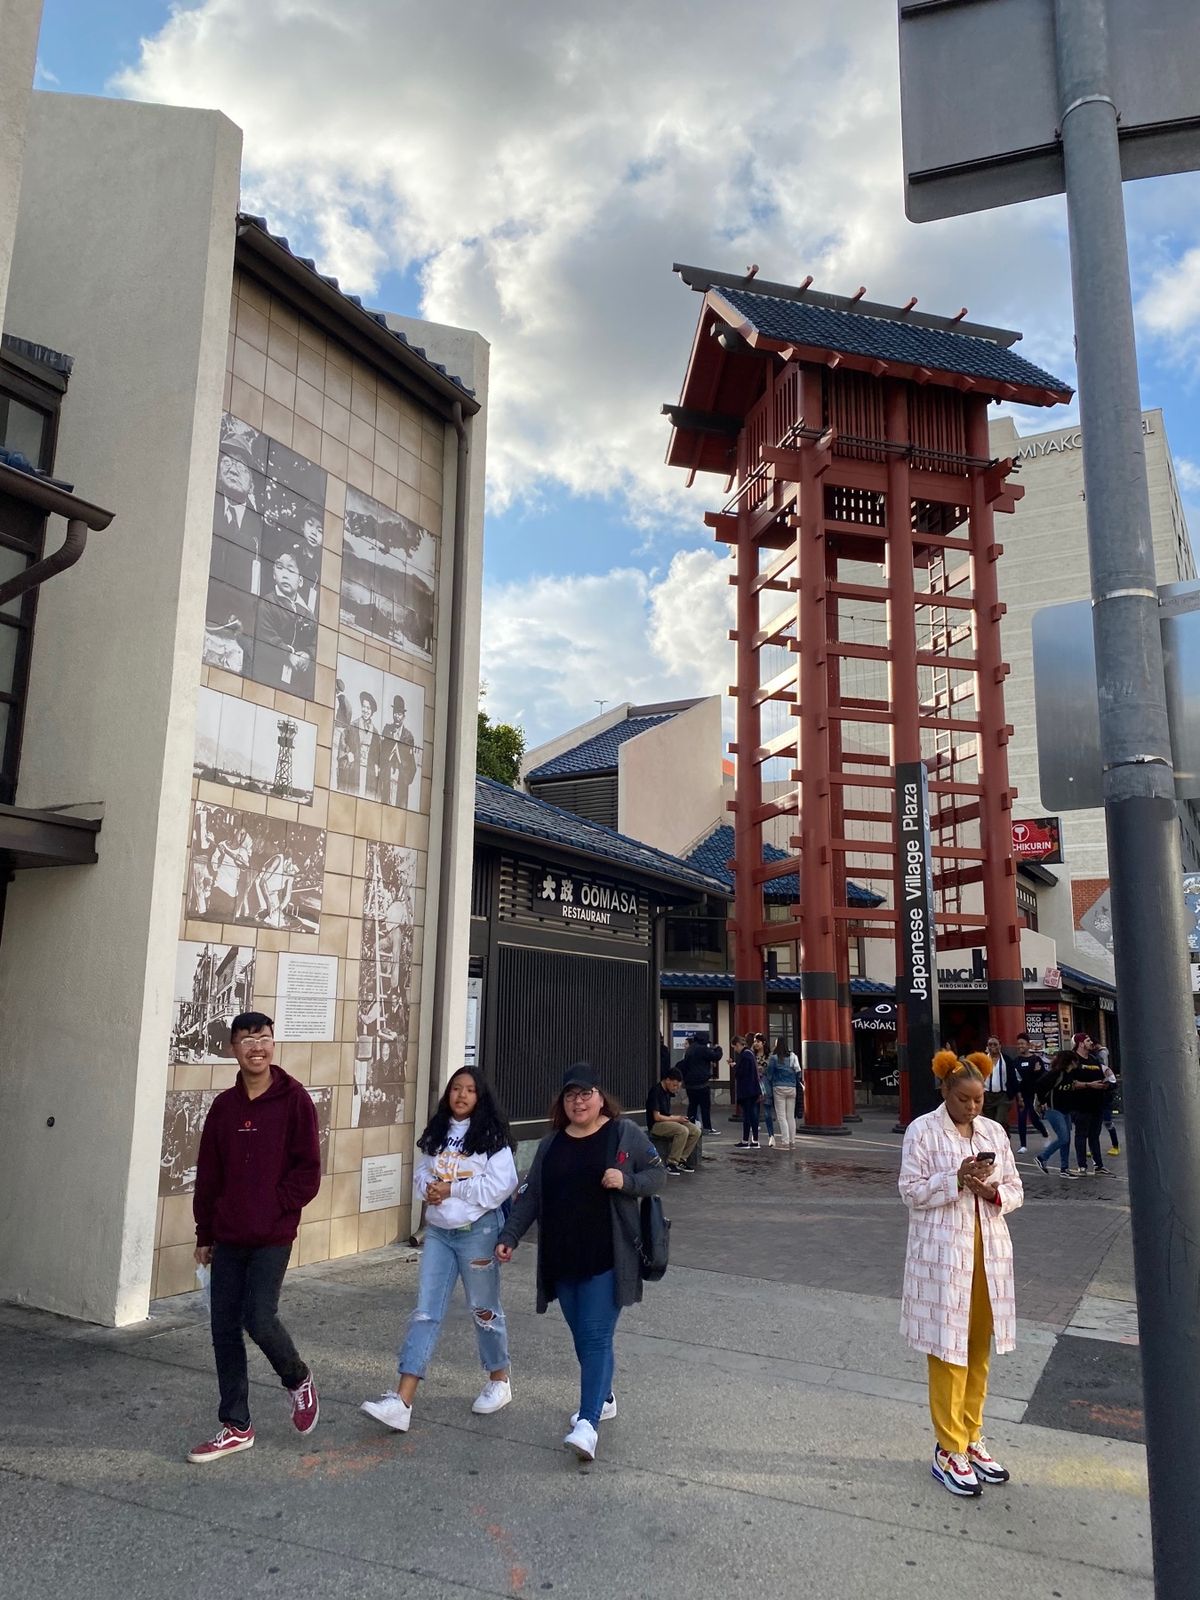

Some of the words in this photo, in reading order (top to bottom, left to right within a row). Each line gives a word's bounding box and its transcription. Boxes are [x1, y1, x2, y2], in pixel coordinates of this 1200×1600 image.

[902, 784, 919, 831] Plaza
[905, 840, 923, 900] Village
[562, 905, 611, 925] RESTAURANT
[910, 908, 929, 1000] Japanese
